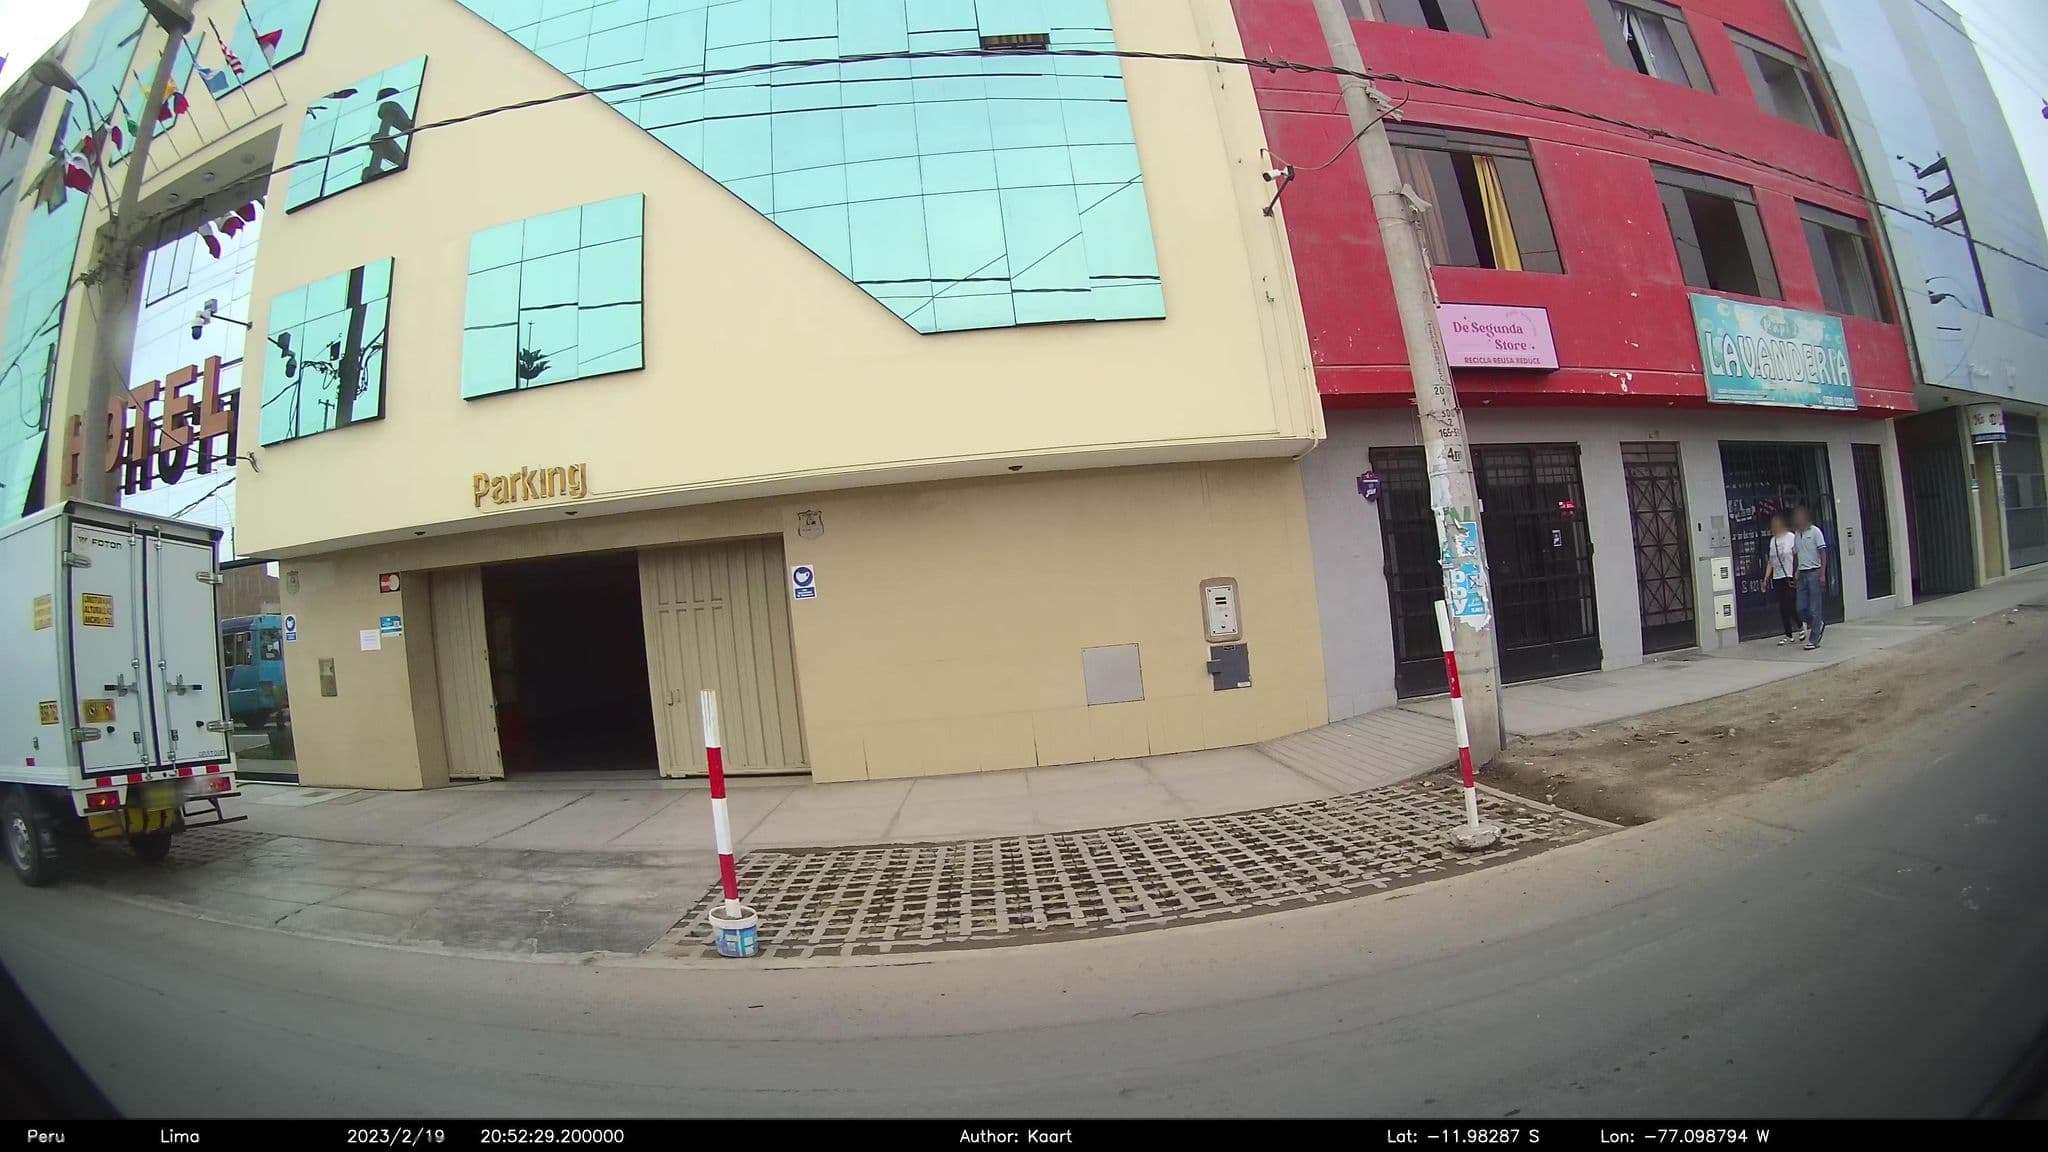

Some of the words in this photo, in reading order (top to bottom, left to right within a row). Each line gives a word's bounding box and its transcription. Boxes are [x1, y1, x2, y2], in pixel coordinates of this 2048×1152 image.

[1453, 321, 1469, 333] De
[1471, 322, 1524, 338] Segunda
[1495, 339, 1528, 351] Store
[1464, 356, 1492, 364] RECICLA
[473, 463, 588, 507] Parking
